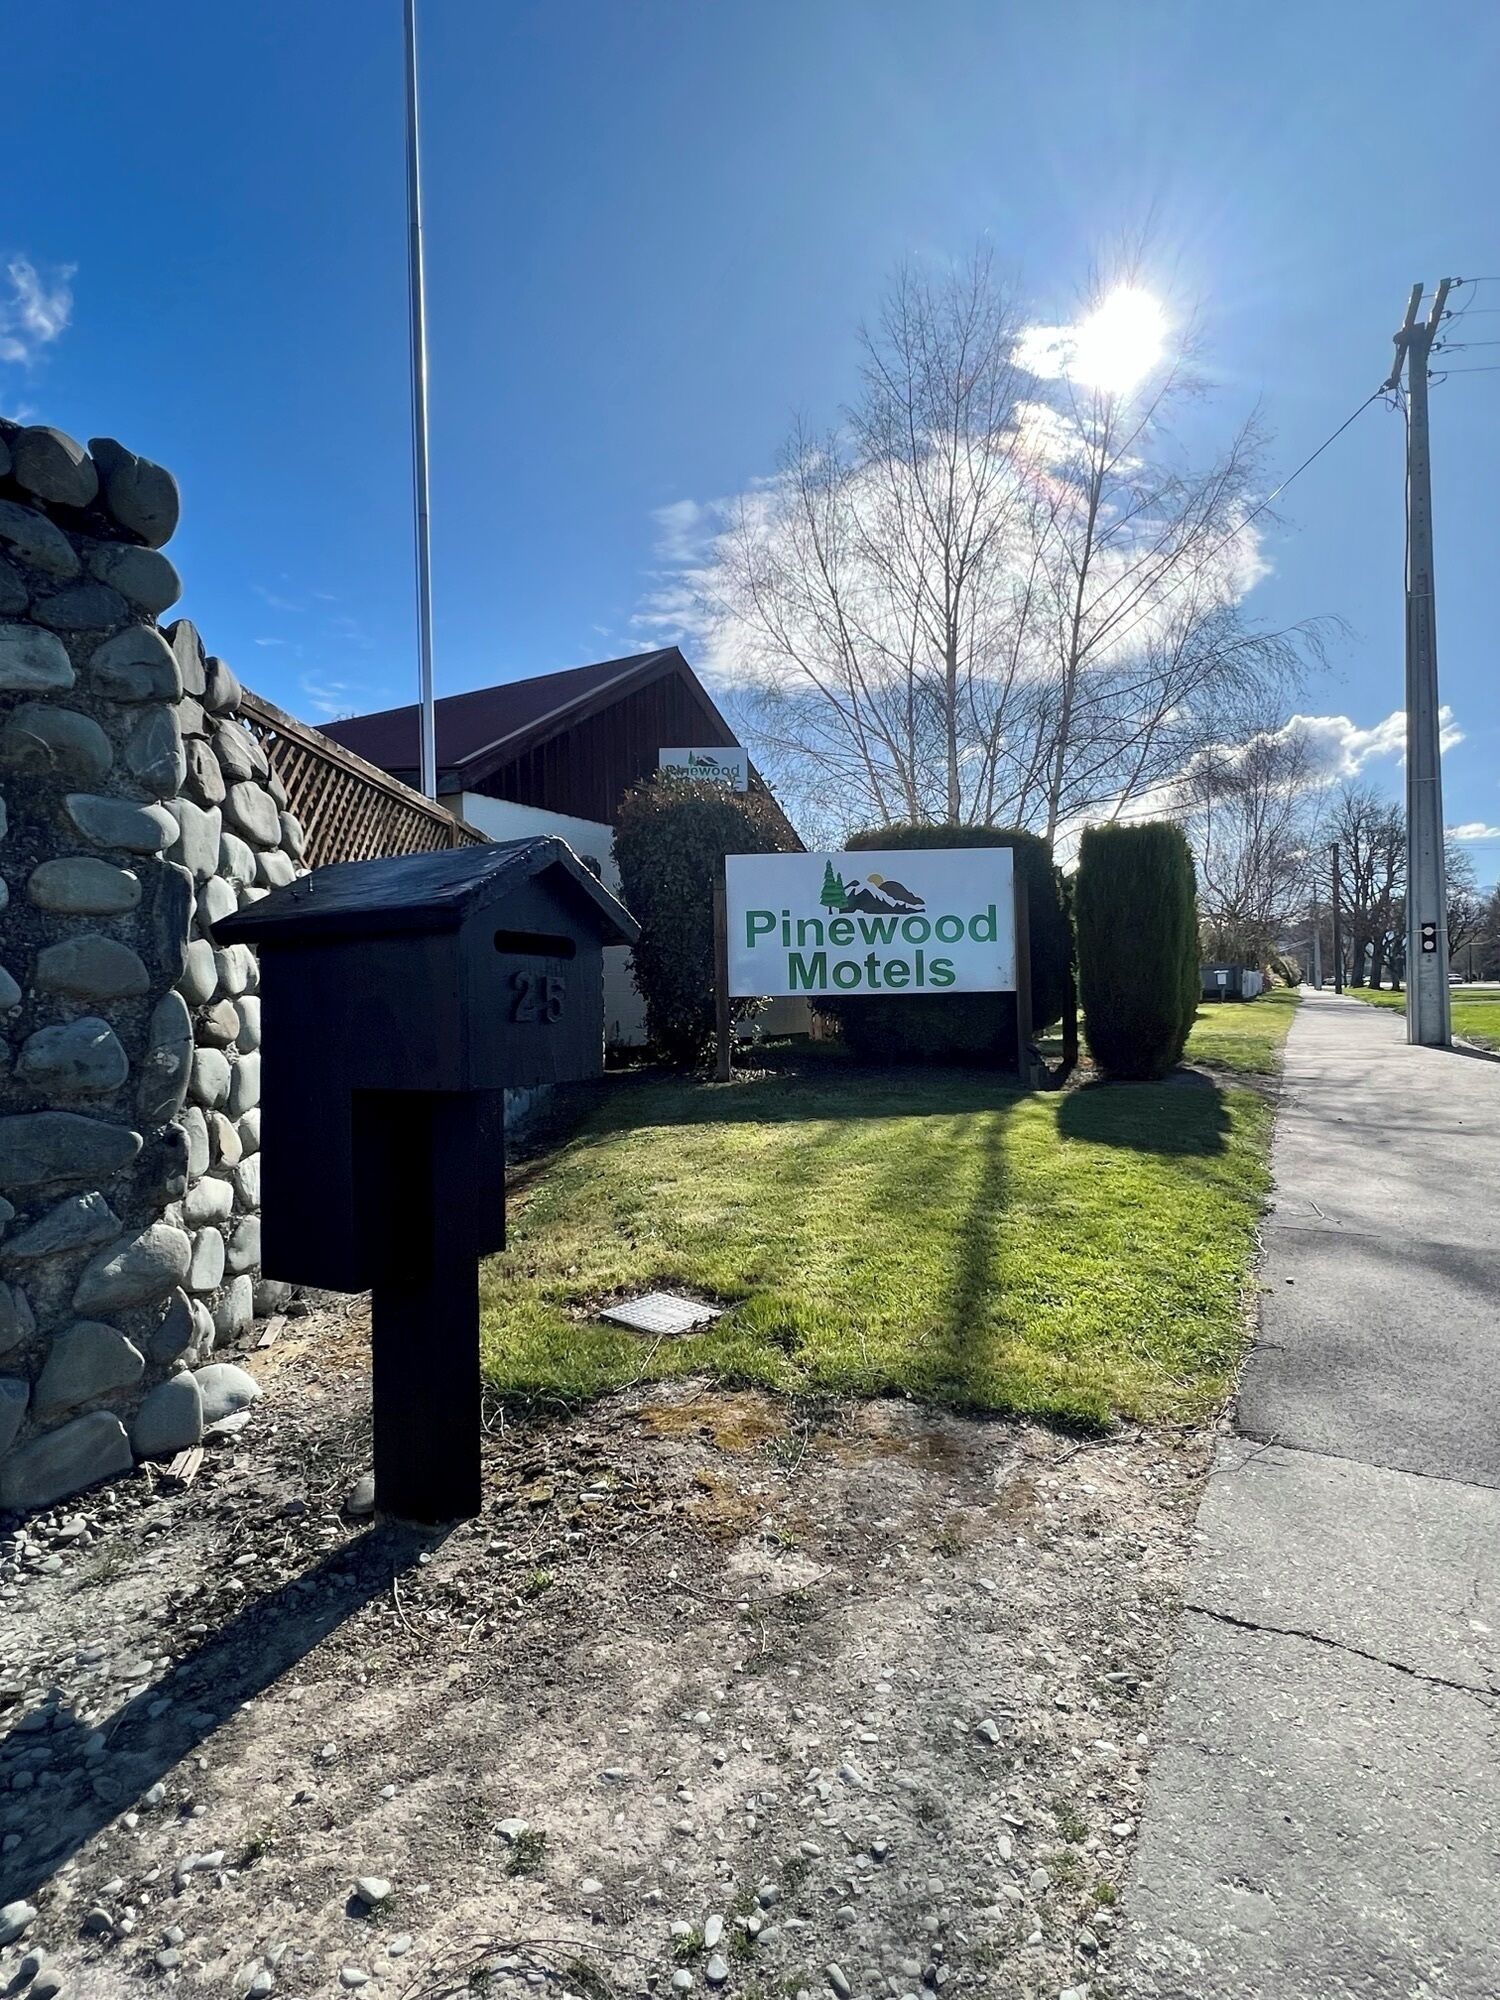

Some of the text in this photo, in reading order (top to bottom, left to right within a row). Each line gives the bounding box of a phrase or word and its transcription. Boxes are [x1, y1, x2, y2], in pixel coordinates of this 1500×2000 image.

[745, 904, 998, 948] Pinewood
[788, 949, 957, 990] Motels
[509, 970, 565, 1024] 25
